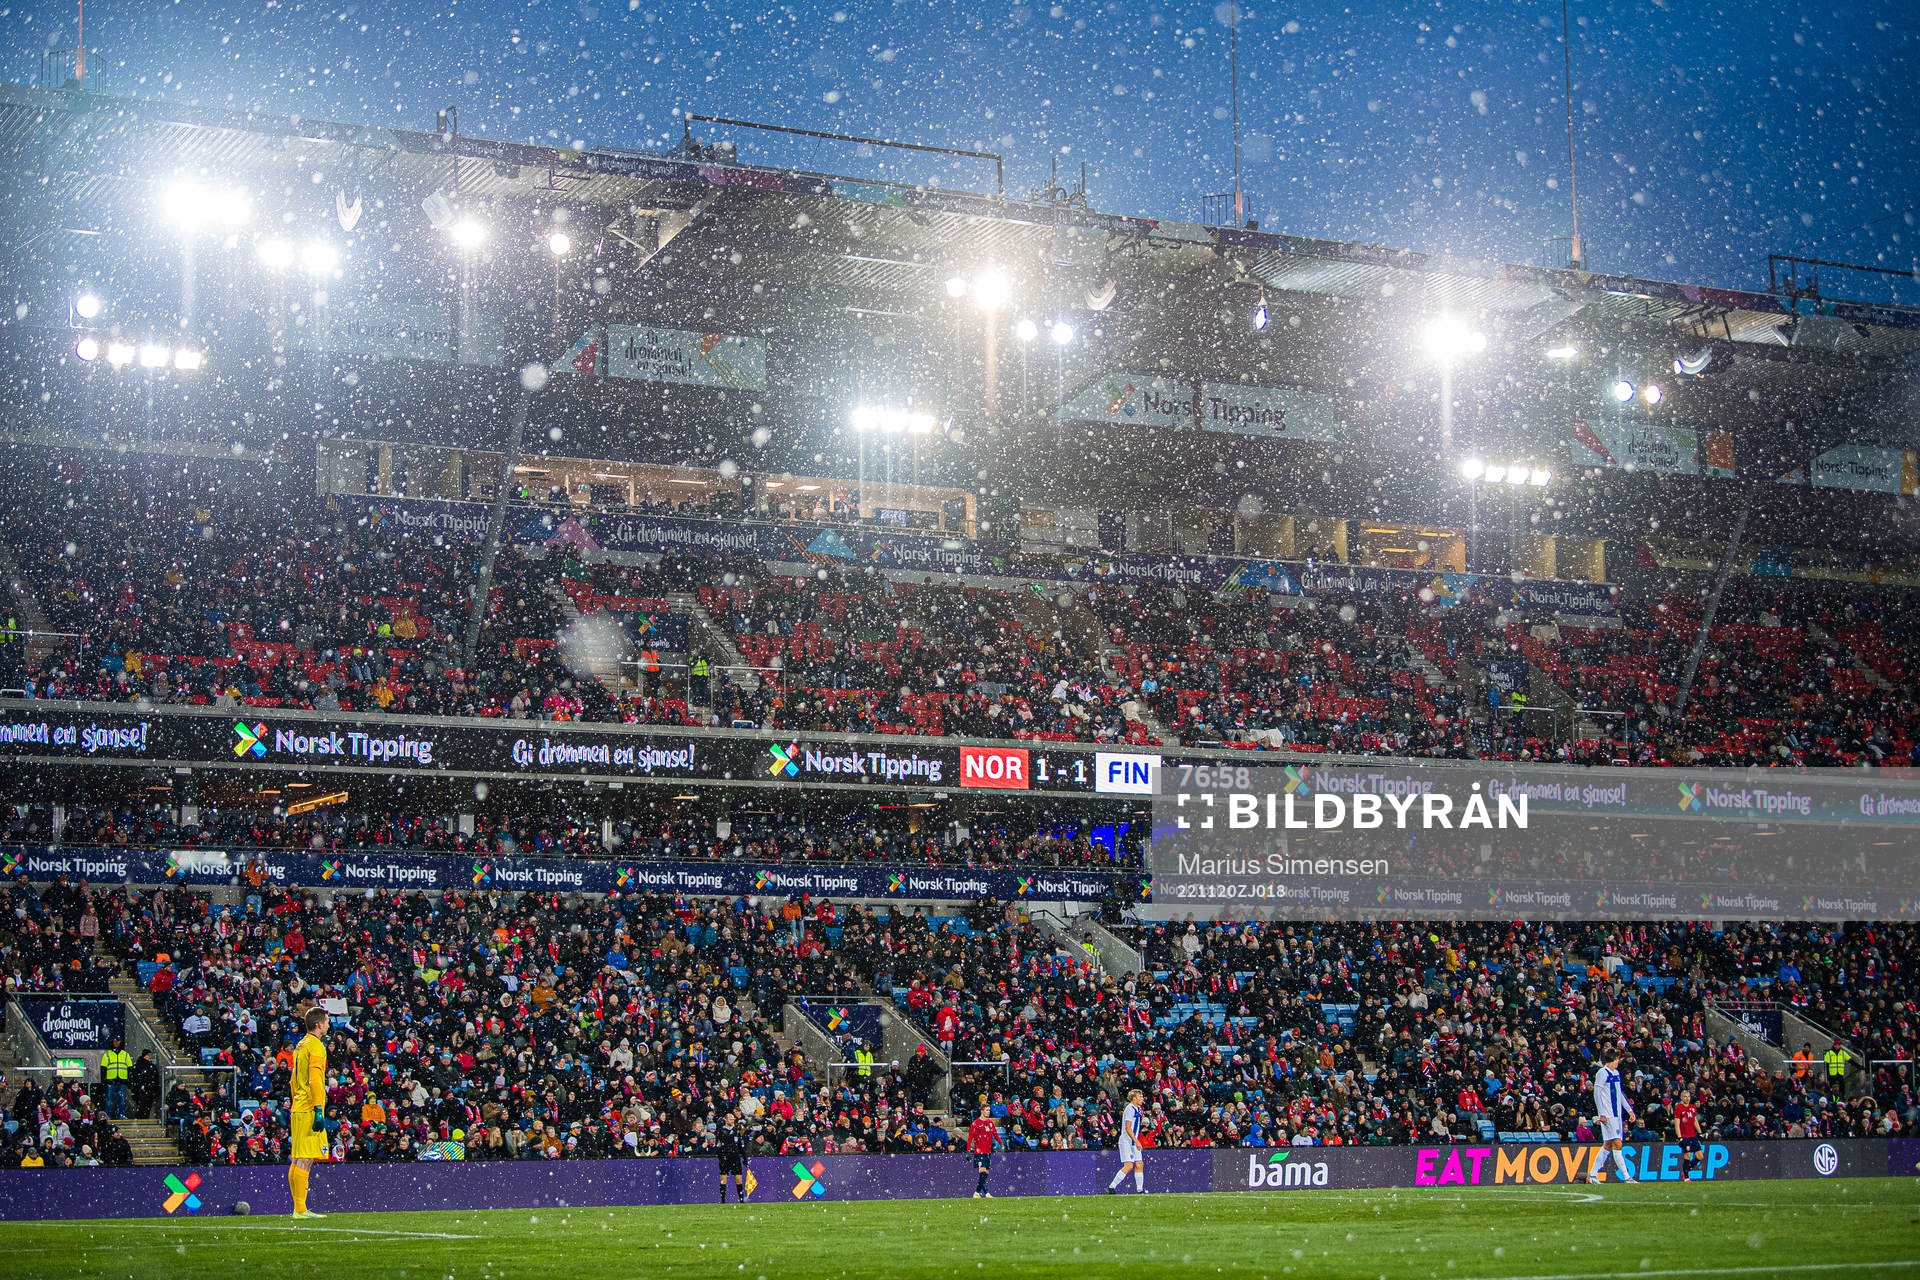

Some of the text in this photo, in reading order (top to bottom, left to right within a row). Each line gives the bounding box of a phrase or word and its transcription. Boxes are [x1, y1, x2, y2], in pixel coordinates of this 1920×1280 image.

[1209, 397, 1286, 431] Tipping
[1816, 459, 1889, 480] Norsk Tipping
[394, 510, 438, 528] Norsk
[616, 521, 633, 543] Gi
[637, 523, 692, 543] drømmen
[694, 530, 710, 545] en
[893, 546, 981, 567] Norsk Tipping
[1119, 562, 1201, 583] Norsk Tipping
[1529, 589, 1602, 610] Norsk Tipping
[54, 725, 76, 744] en
[82, 722, 147, 752] sjanse!
[275, 729, 433, 764] Norsk Tipping
[513, 738, 695, 773] Gi drømmen en sjanse!
[805, 750, 942, 782] Norsk Tipping
[965, 755, 1022, 780] NOR
[1036, 759, 1049, 781] 1
[1074, 760, 1087, 782] 1
[1109, 761, 1149, 785] FIN
[1178, 764, 1250, 789] 76:58
[1315, 771, 1432, 797] Norsk Tipping
[1564, 784, 1580, 801] en
[1583, 783, 1627, 808] sjanse!
[1706, 788, 1811, 814] Norsk Tipping
[1860, 794, 1874, 815] Gi
[28, 858, 127, 877] Norsk Tipping
[190, 861, 232, 876] Norsk
[346, 864, 437, 883] Norsk Tipping
[495, 867, 583, 885] Norsk Tipping
[638, 871, 723, 889] Norsk Tipping
[777, 874, 858, 891] Norsk Tipping
[909, 877, 988, 894] Norsk Tipping
[1037, 880, 1108, 896] Norsk Tippin
[1311, 886, 1349, 902] Tipping
[1395, 888, 1463, 904] Norsk Tipping
[1505, 891, 1571, 907] Norsk Tipping
[1612, 893, 1677, 908] Norsk Tipping
[1717, 895, 1779, 911] Norsk Tipping
[1818, 898, 1877, 913] Norsk Tipping
[60, 1005, 71, 1018] Gi
[42, 1012, 91, 1032] drømmen
[52, 1030, 63, 1039] en
[65, 1025, 99, 1046] sjanse!
[1414, 1147, 1491, 1186] EAT
